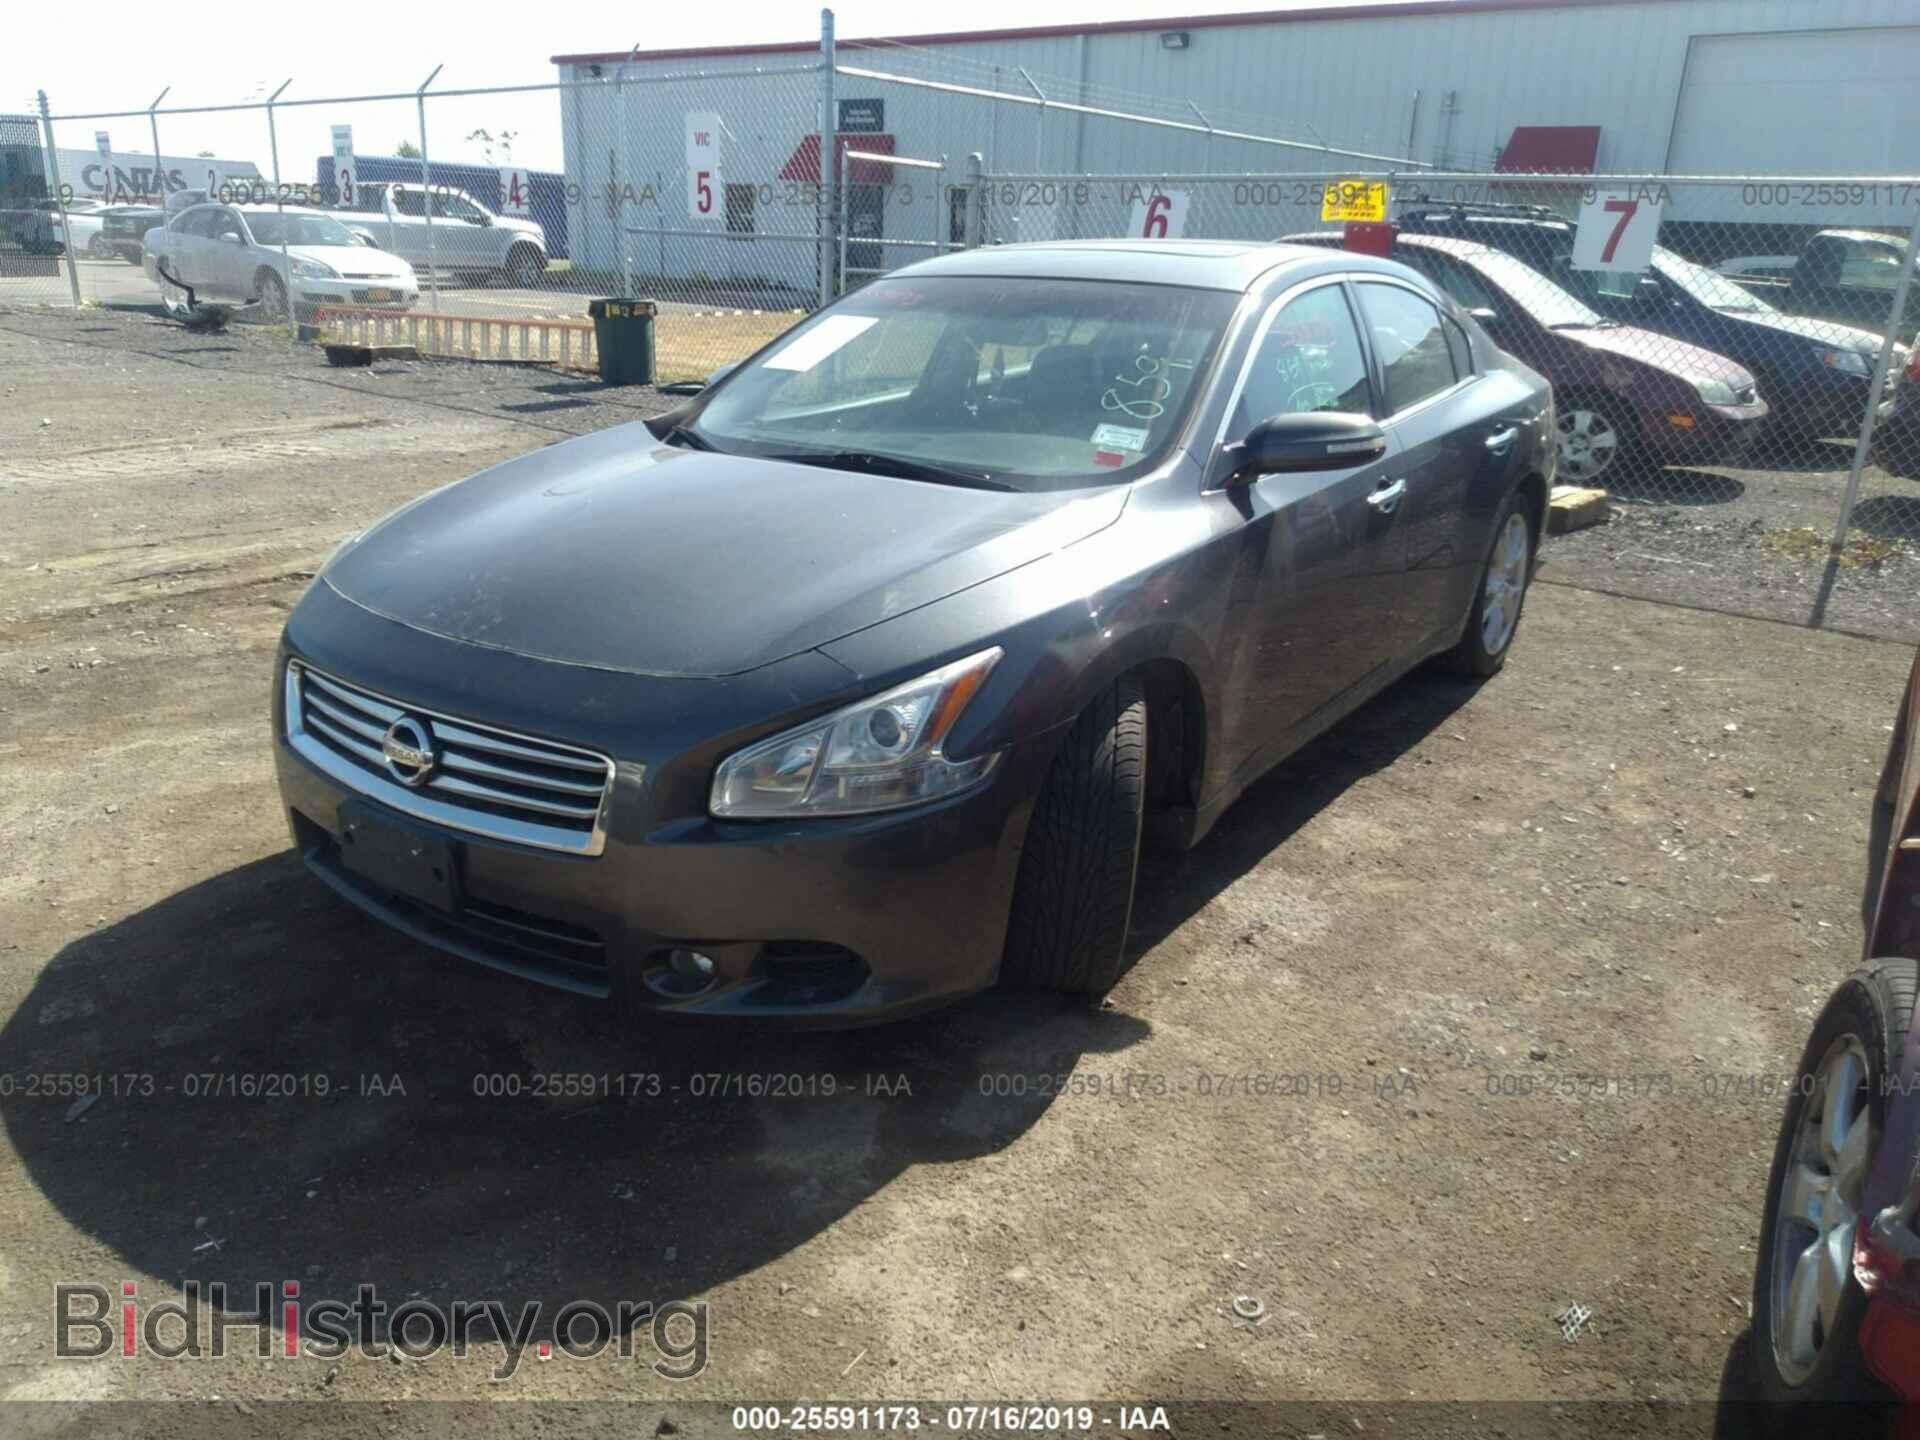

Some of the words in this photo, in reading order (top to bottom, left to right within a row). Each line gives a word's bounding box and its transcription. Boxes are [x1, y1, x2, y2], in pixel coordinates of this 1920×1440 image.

[694, 132, 711, 147] VIC
[81, 164, 188, 194] CNTAS
[208, 169, 217, 199] 2
[341, 169, 351, 202] 3
[512, 172, 522, 209] 4
[697, 172, 712, 213] 5
[1142, 195, 1172, 239] 6
[1600, 200, 1638, 263] 7
